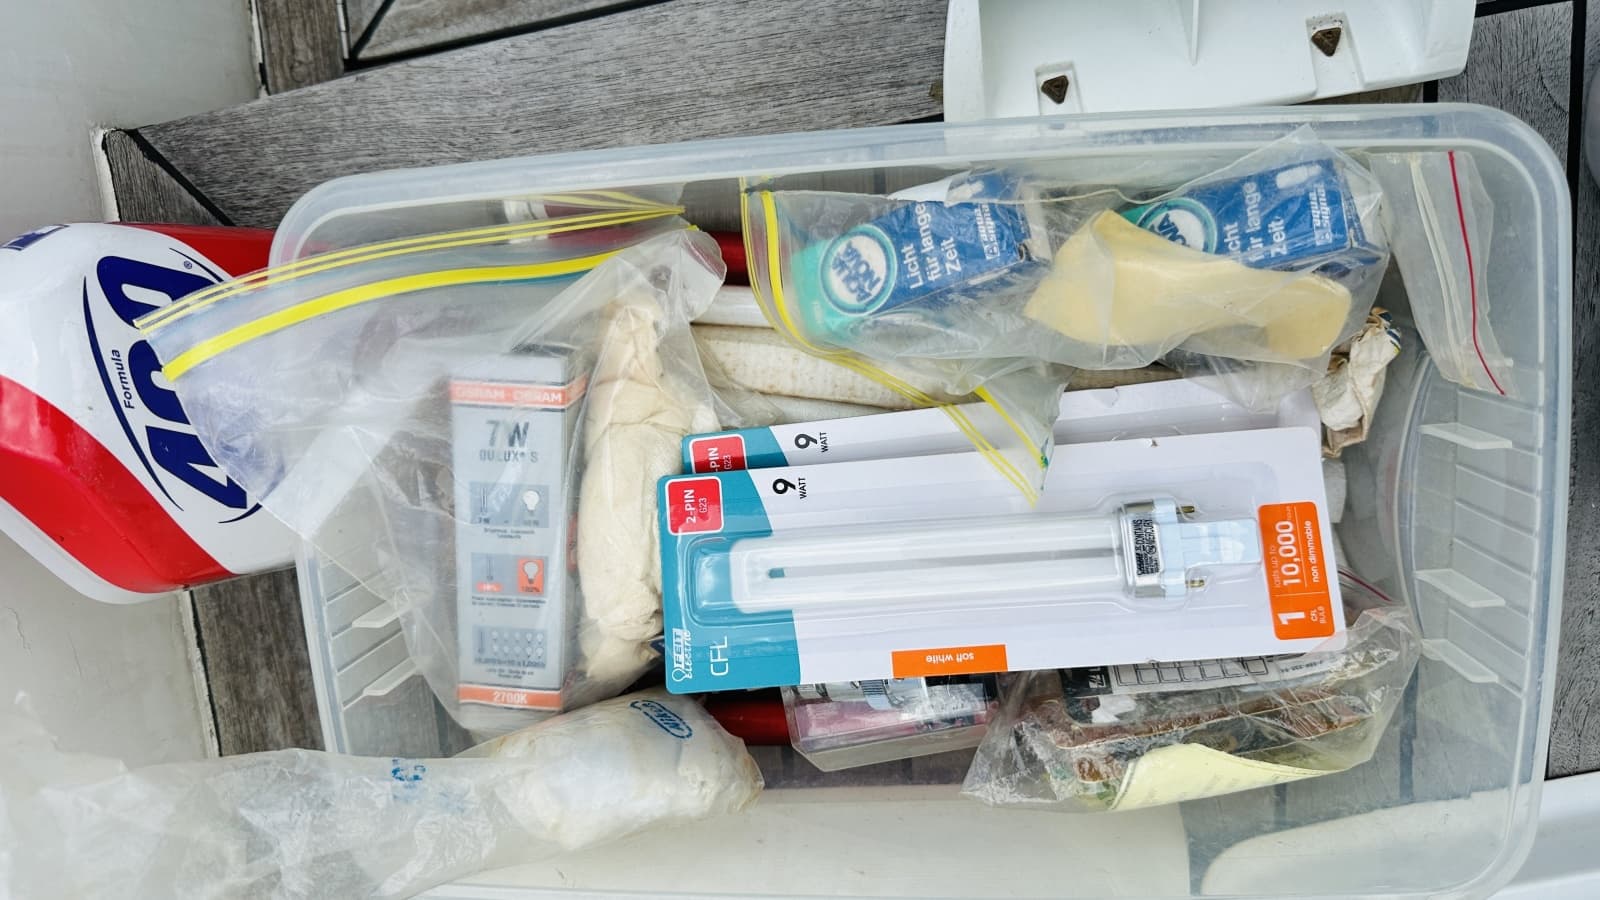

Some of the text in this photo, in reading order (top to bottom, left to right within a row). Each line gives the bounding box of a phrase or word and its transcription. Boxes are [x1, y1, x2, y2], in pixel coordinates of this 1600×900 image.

[1243, 182, 1262, 233] lange
[915, 203, 943, 282] für lange
[1268, 216, 1288, 257] Zeit
[902, 243, 923, 289] Licht
[941, 237, 962, 275] Zeit
[111, 349, 134, 409] Formula
[794, 433, 818, 449] 9
[820, 432, 829, 453] WATT
[772, 478, 796, 494] 9
[798, 477, 807, 499] WATT
[684, 489, 697, 524] 2-PIN
[1275, 520, 1301, 586] 10,000
[1304, 520, 1318, 564] dimmable
[1278, 611, 1305, 625] 1
[1318, 606, 1327, 624] BULB
[674, 632, 684, 666] FEIT
[710, 636, 729, 677] CFL
[926, 651, 974, 663] soft white
[493, 691, 528, 704] 2700K
